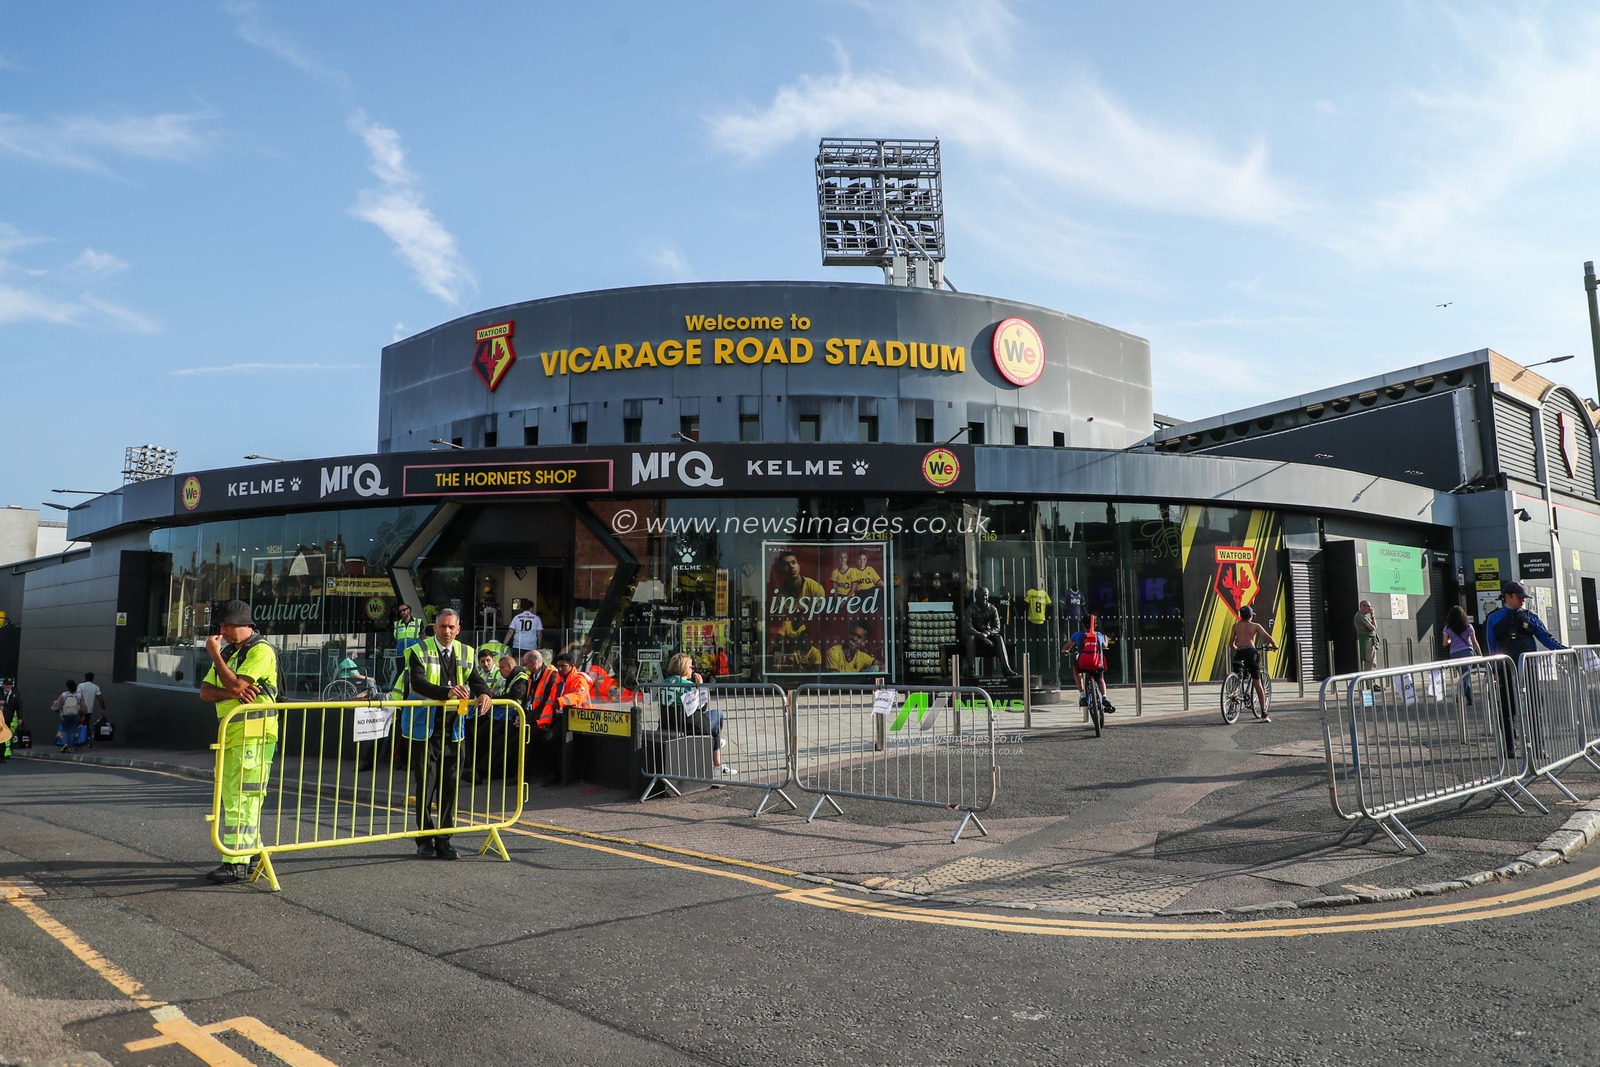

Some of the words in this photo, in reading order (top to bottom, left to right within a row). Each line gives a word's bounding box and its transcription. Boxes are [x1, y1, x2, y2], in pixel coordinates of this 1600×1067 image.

[685, 313, 783, 331] Welcome
[790, 313, 811, 330] to
[478, 325, 508, 339] WATFORD
[540, 338, 702, 377] VICARAGE
[714, 337, 814, 364] ROAD
[825, 338, 966, 373] STADIUM
[1003, 338, 1037, 365] We
[631, 450, 724, 488] MrQ
[747, 460, 844, 476] KELME
[928, 461, 954, 475] We
[320, 462, 389, 499] MrQ
[435, 472, 459, 487] THE
[464, 471, 531, 486] HORNETS
[535, 469, 577, 485] SHOP
[185, 487, 198, 499] We
[228, 478, 285, 497] KELME
[1219, 550, 1252, 560] WATFORD
[253, 597, 321, 621] cultured
[368, 603, 383, 613] We
[769, 588, 880, 621] inspired
[1035, 601, 1042, 613] 8
[519, 619, 533, 632] 10
[577, 710, 602, 721] YELLOW
[604, 712, 624, 724] BRICK
[590, 722, 609, 733] ROAD
